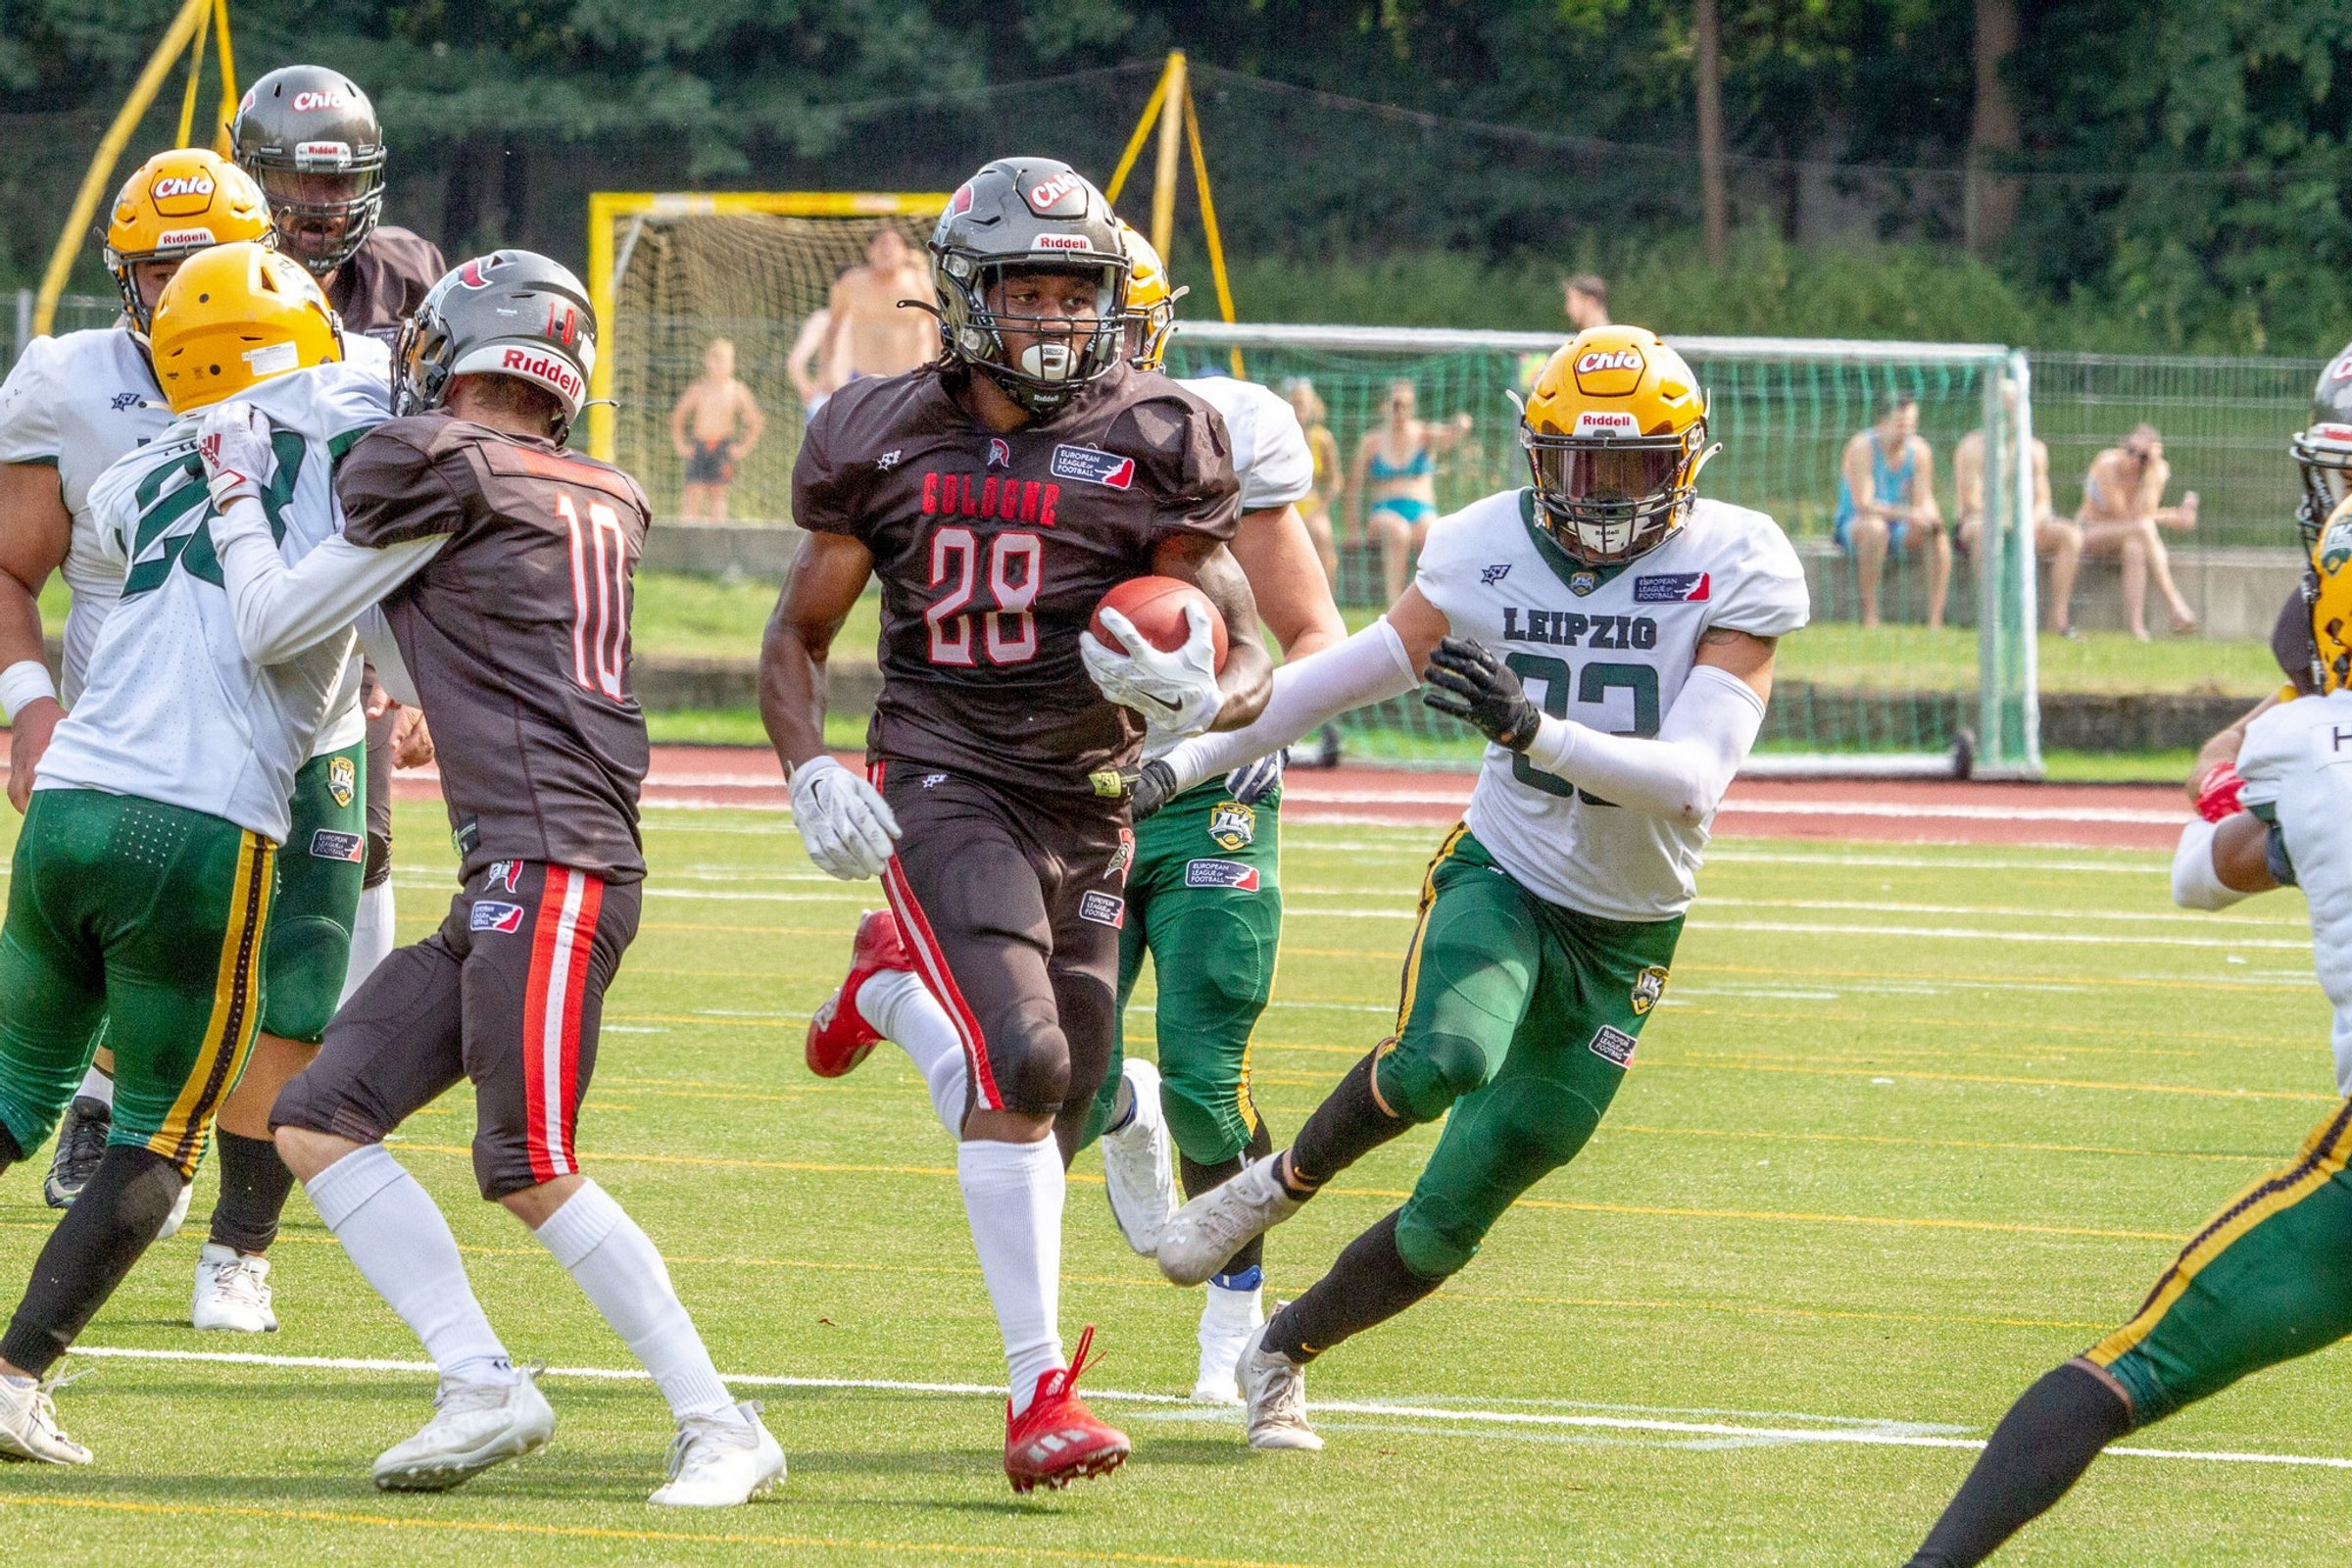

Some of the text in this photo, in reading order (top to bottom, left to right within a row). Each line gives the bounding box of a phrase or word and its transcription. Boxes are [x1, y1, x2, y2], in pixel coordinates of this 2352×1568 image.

[292, 92, 344, 112] Chio
[308, 145, 338, 155] Riddell
[155, 176, 215, 198] Chio
[1029, 173, 1080, 212] Chio
[164, 232, 208, 245] Riddell
[1040, 237, 1087, 249] Riddell
[1577, 350, 1642, 374] Chio
[502, 349, 581, 401] Riddell
[1583, 415, 1631, 426] Riddell
[1058, 458, 1088, 468] LEAGUE
[1060, 449, 1101, 463] EUROPEAN
[1057, 465, 1095, 477] FOOTBALL
[921, 471, 1059, 527] COLOGNE
[556, 492, 628, 704] 10
[923, 525, 1044, 667] 28
[1503, 607, 1657, 651] LEIPZIG
